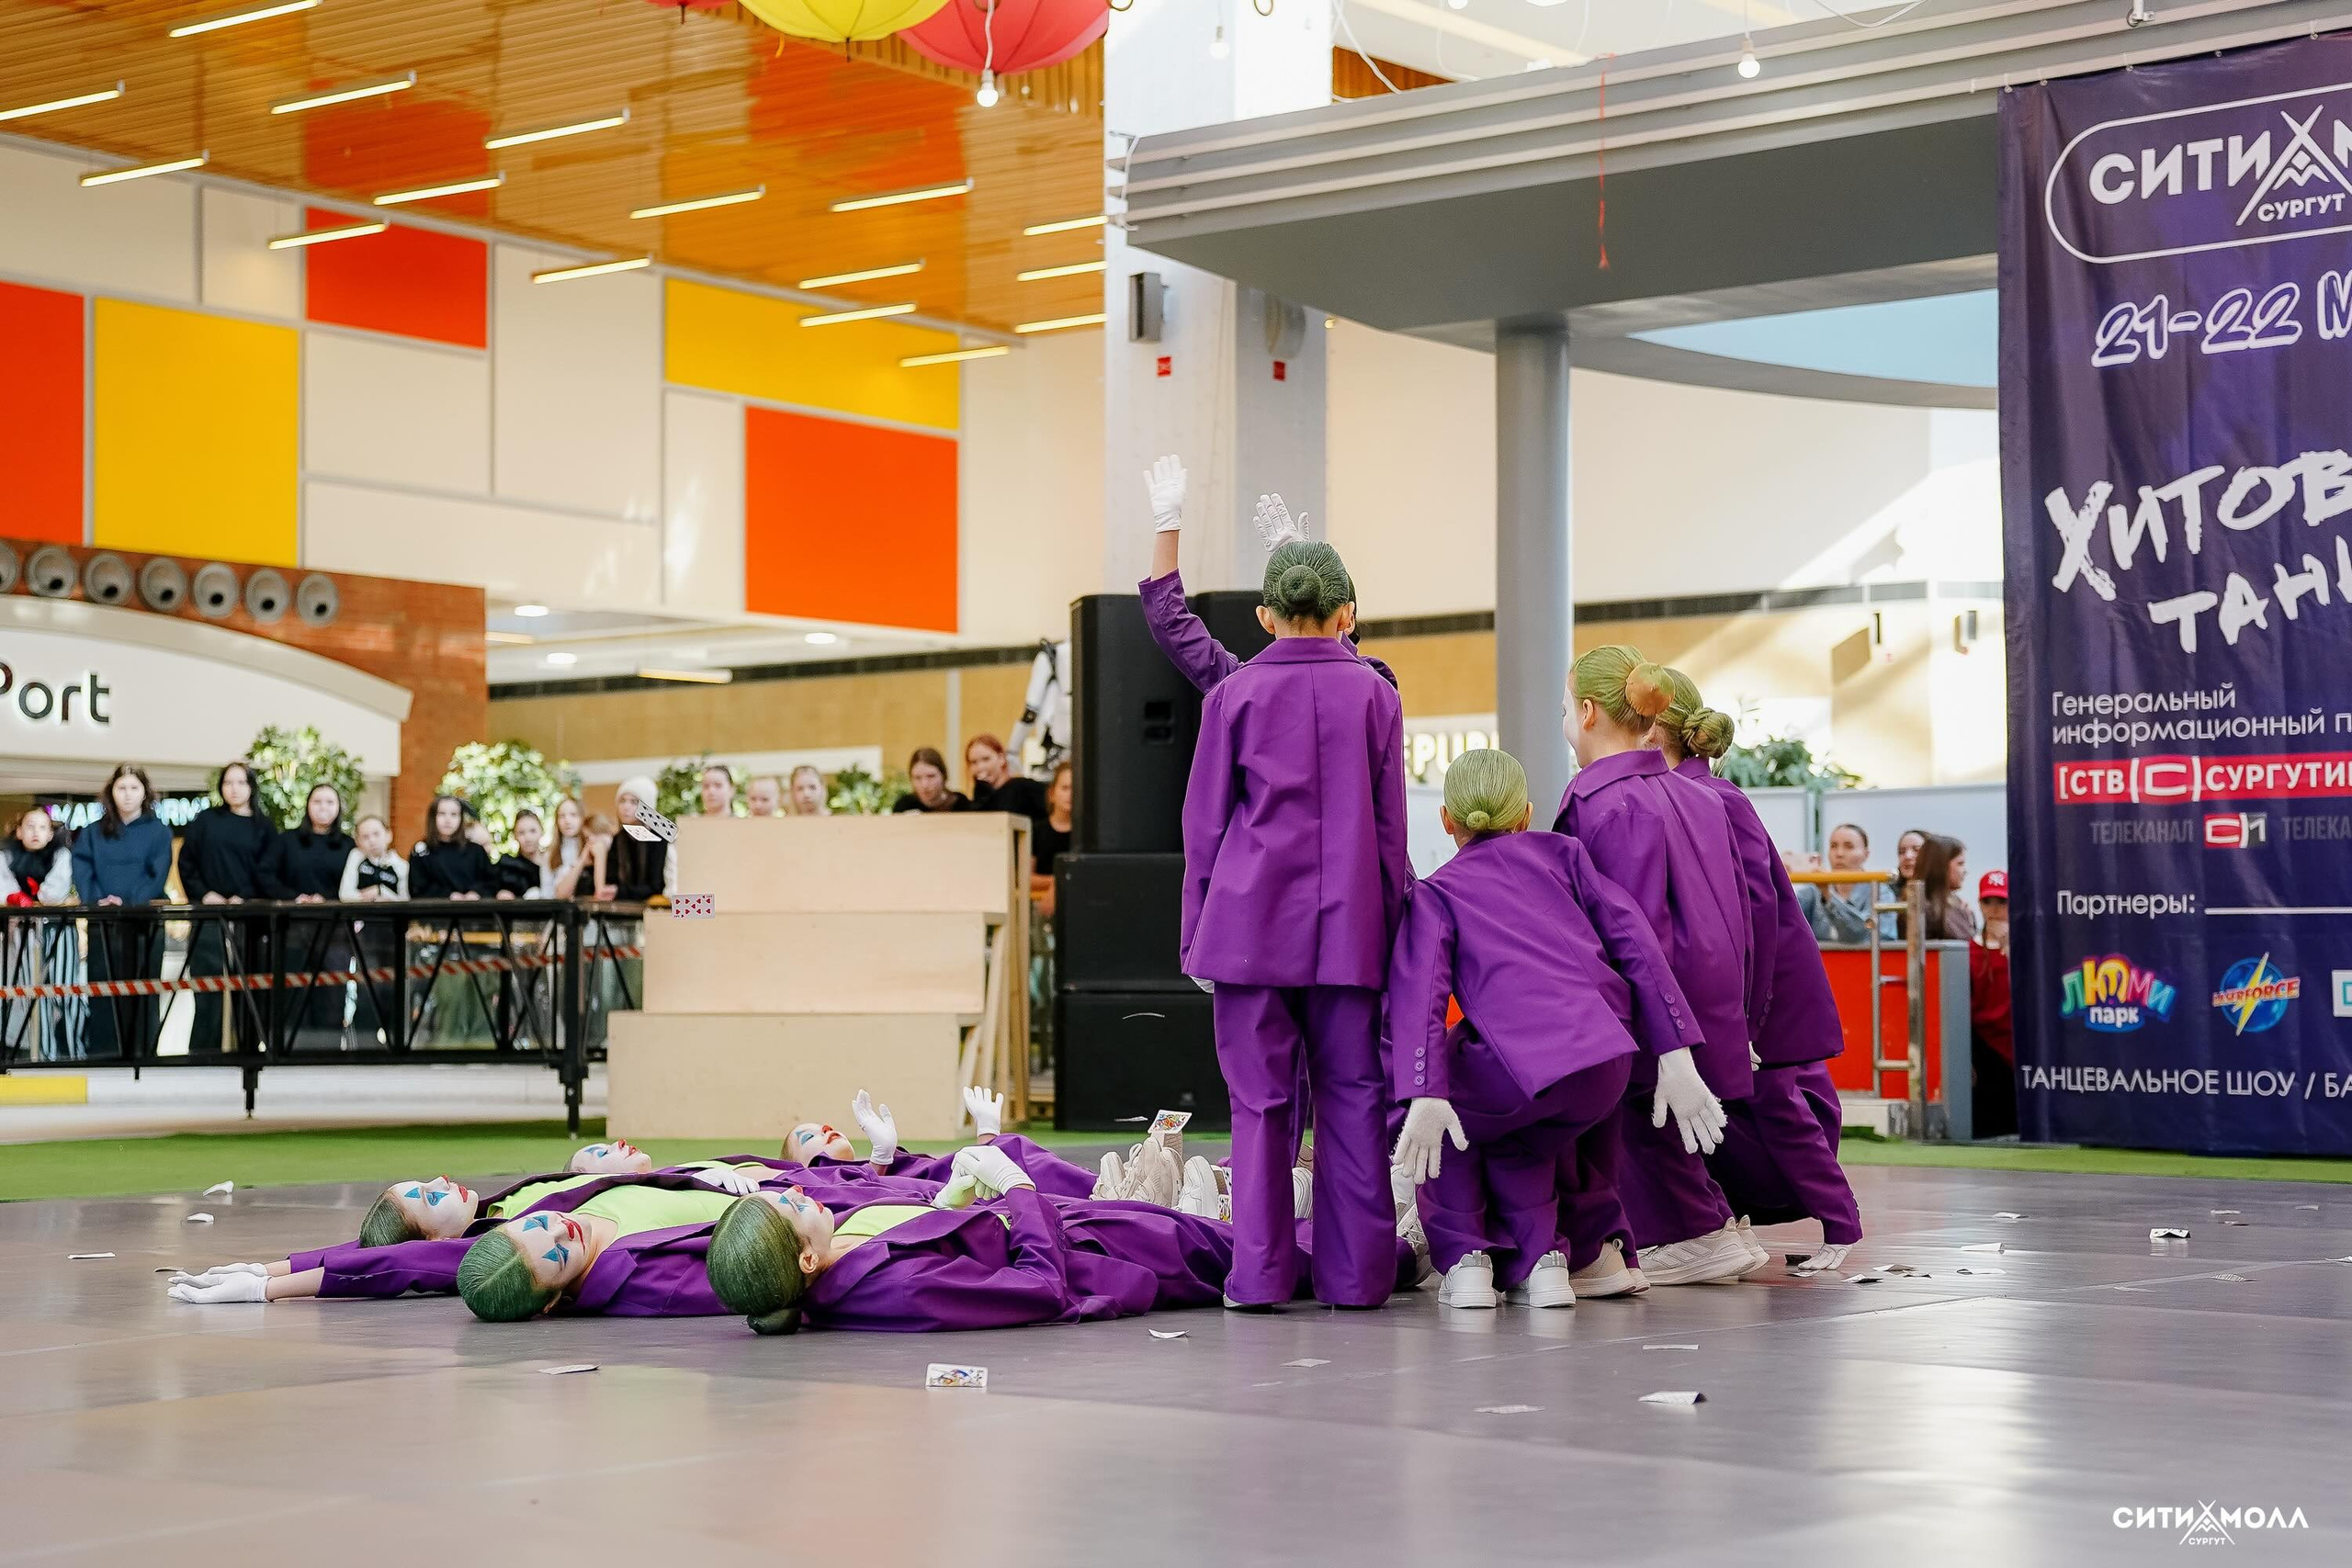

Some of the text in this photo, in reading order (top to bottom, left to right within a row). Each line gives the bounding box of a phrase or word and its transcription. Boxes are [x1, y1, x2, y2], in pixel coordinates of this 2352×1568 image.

[2089, 130, 2271, 205] СИТИ
[2257, 192, 2346, 222] СУРГУТ
[2091, 281, 2303, 367] 21-22
[2044, 448, 2352, 602] ХИТОВ
[2052, 682, 2236, 719] Генеральный
[2052, 707, 2325, 749] информационный
[2205, 761, 2352, 791] СУРГУТИ
[2090, 819, 2195, 845] ТЕЛЕКАНАЛ
[2057, 890, 2197, 919] Партнеры:
[2089, 1007, 2139, 1028] парк
[2021, 1066, 2221, 1095] ТАНЦЕВАЛЬНОЕ
[2226, 1070, 2296, 1097] ШОУ
